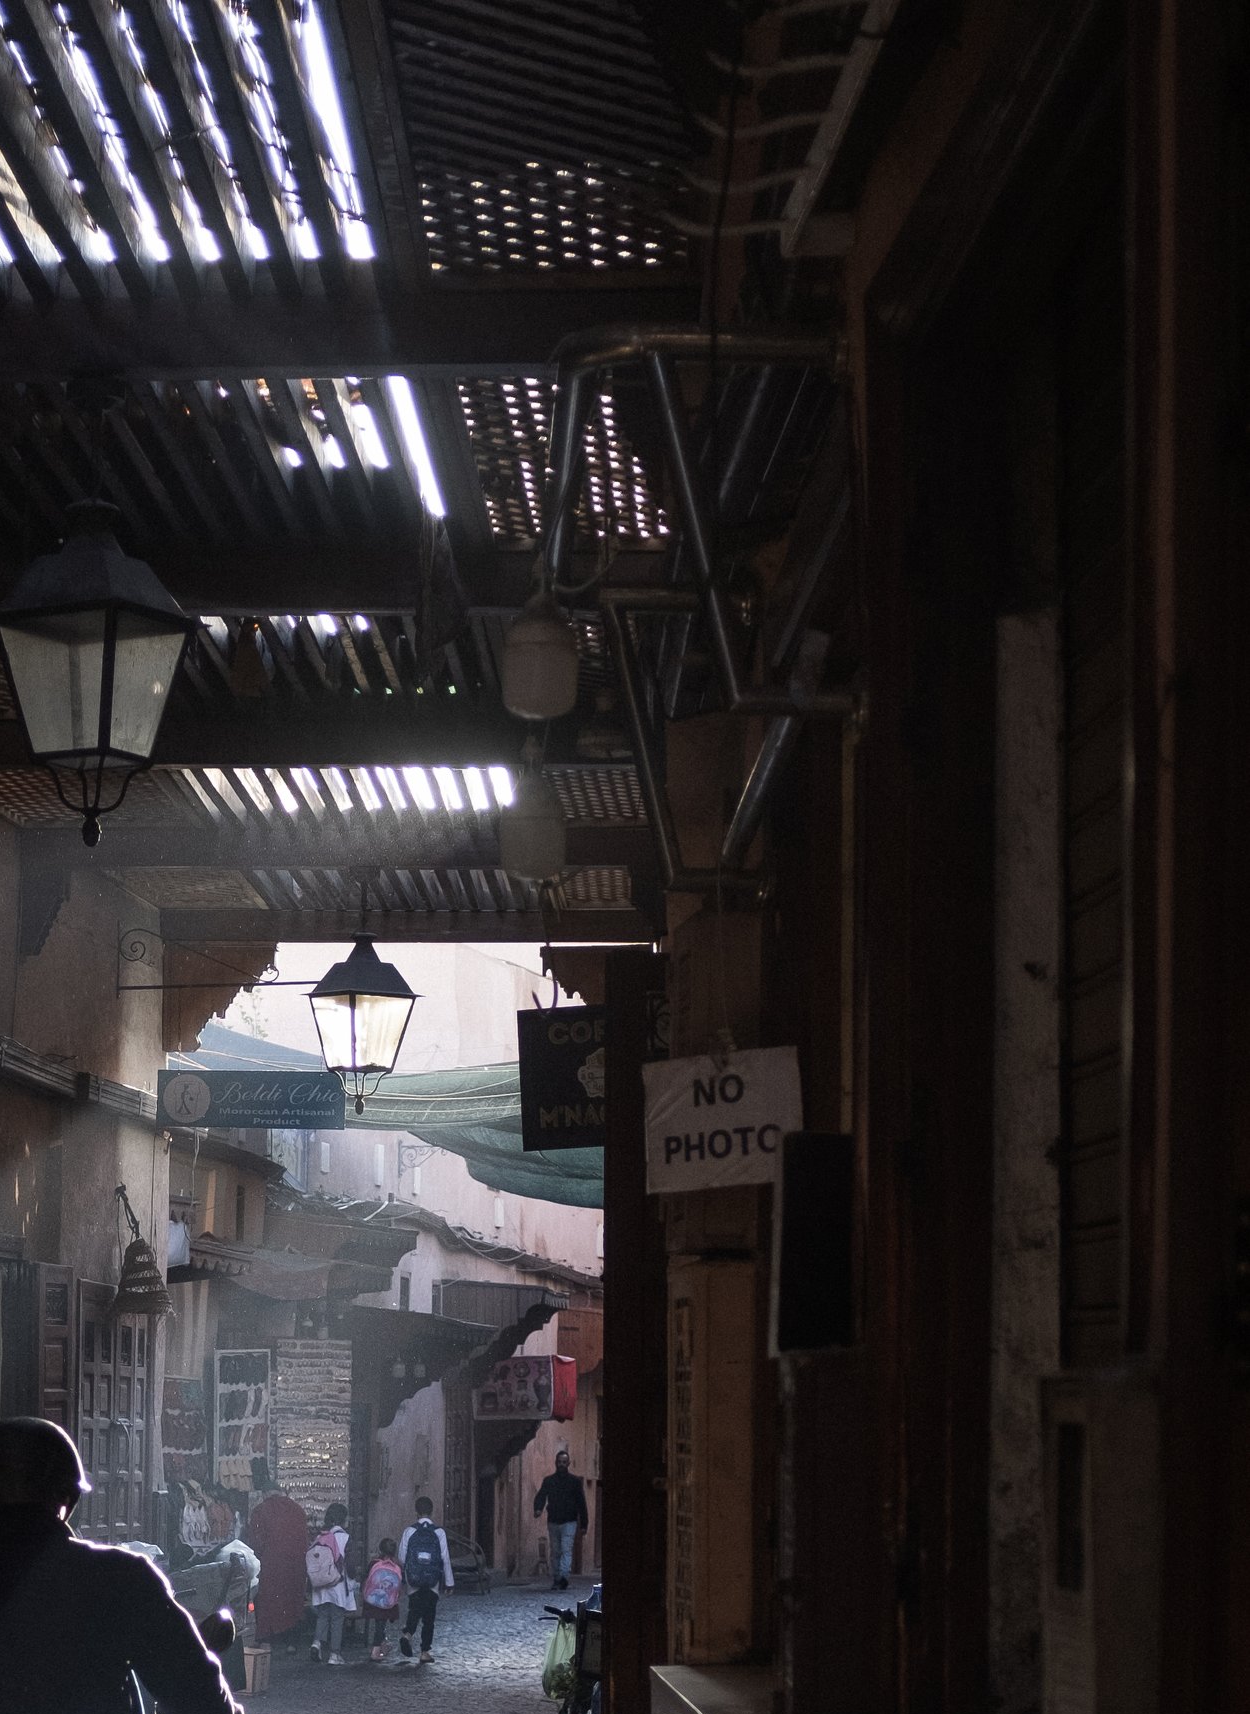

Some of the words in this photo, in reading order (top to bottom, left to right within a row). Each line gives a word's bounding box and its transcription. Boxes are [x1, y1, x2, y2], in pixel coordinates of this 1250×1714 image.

[214, 1082, 283, 1104] Beldi
[288, 1082, 342, 1105] Chic
[693, 1074, 745, 1107] NO
[220, 1108, 278, 1116] Moroccan
[283, 1108, 335, 1116] Artisanal
[253, 1118, 300, 1126] Product
